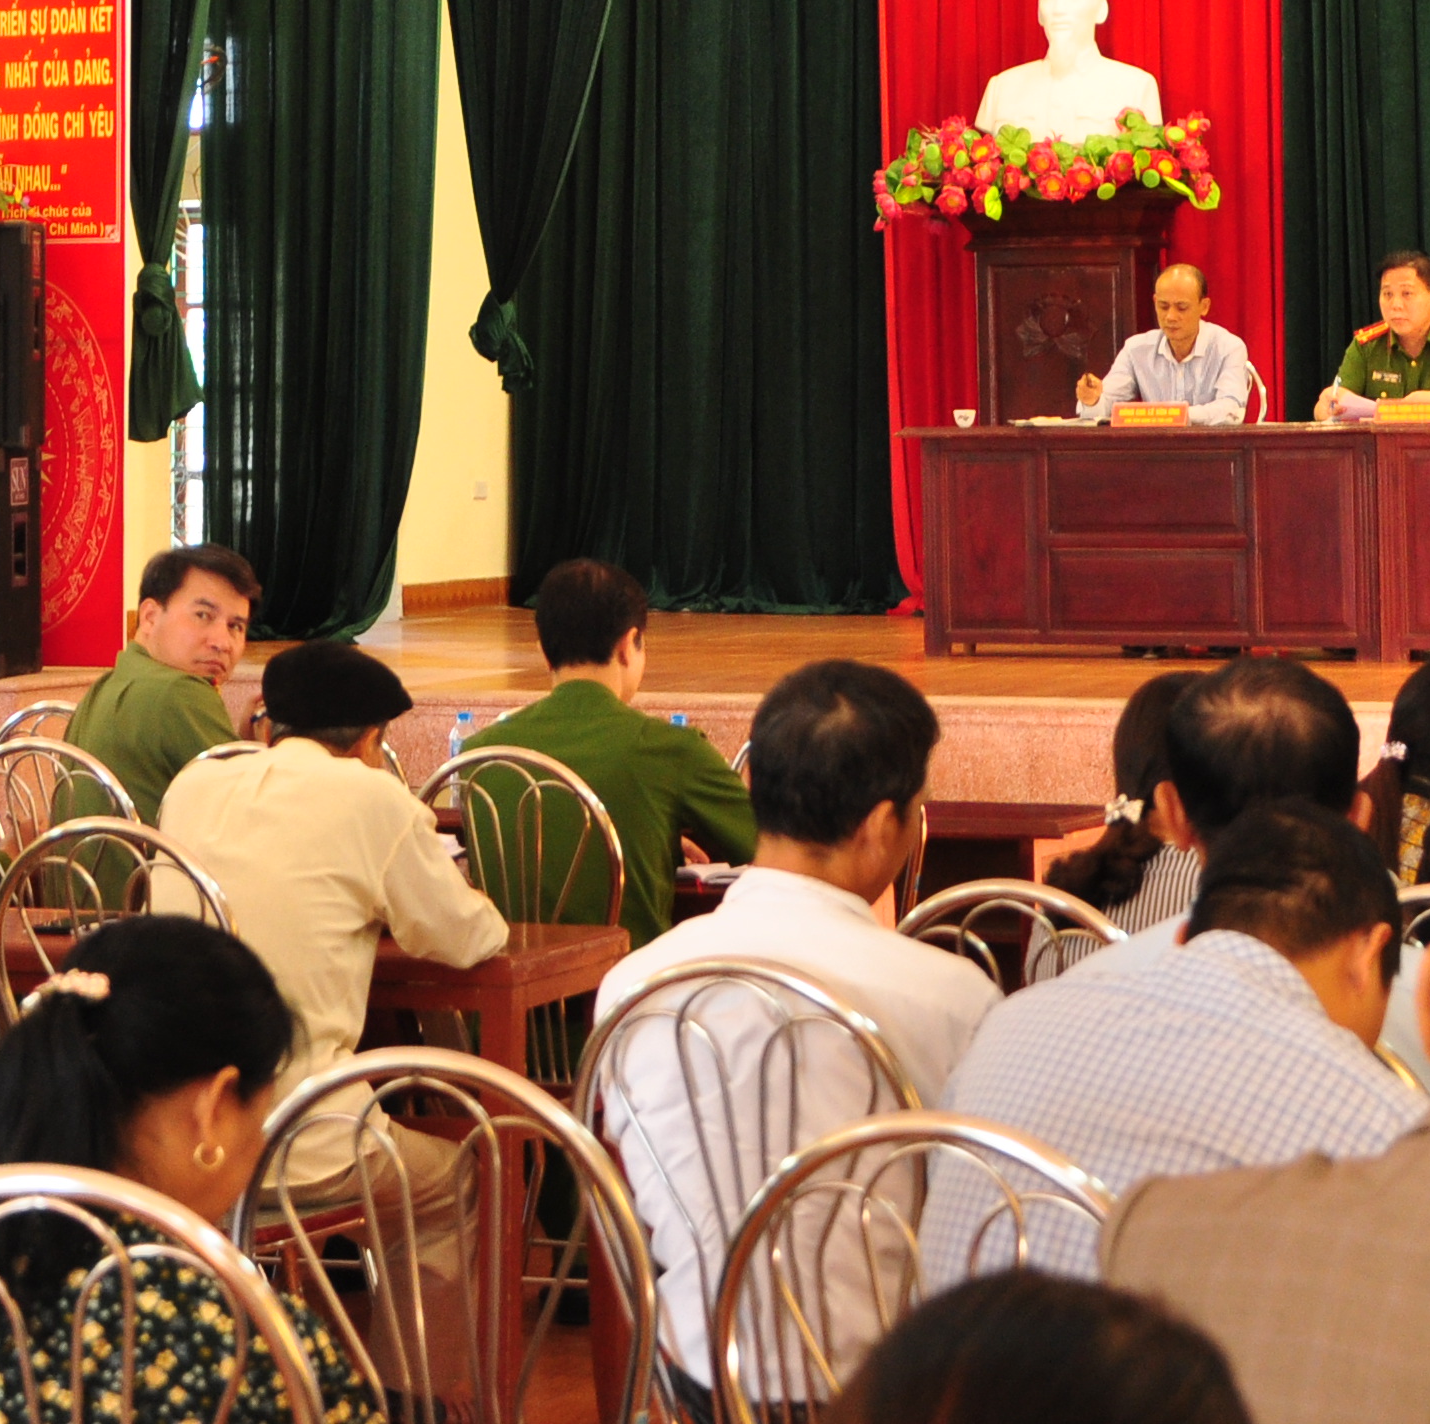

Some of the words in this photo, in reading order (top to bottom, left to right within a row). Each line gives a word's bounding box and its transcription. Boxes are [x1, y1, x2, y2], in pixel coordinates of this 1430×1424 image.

[50, 1, 86, 34] ĐOÀN
[5, 50, 38, 88] NHẤT
[43, 48, 69, 87] CỦA
[64, 105, 84, 138] CHÍ
[89, 104, 113, 137] YÊU
